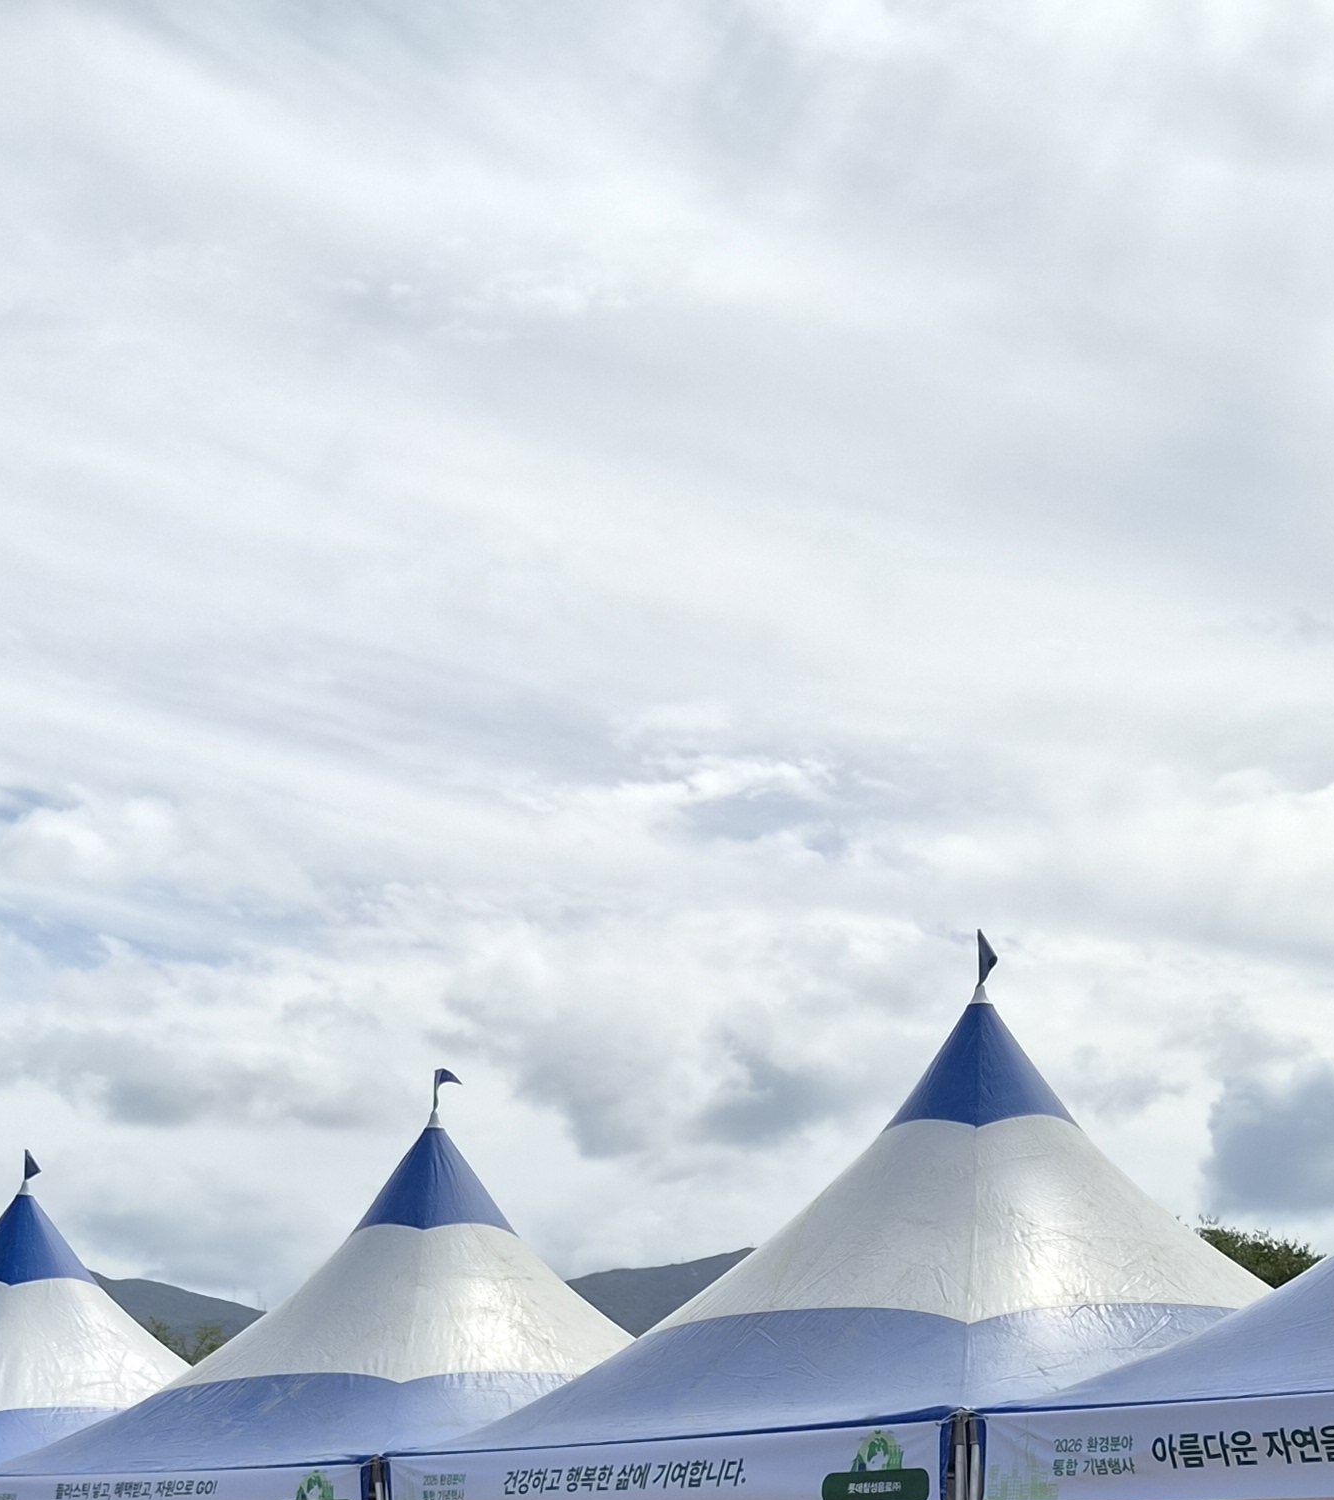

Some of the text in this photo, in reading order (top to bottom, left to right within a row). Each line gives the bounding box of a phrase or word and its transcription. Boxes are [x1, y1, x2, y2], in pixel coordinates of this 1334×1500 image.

[1052, 1434, 1134, 1454] 2026 환경분야
[1150, 1430, 1259, 1471] 아름다운
[502, 1457, 748, 1496] 건강하고 행복한 삶에 기여합니다.
[1052, 1456, 1135, 1477] 통합 기념행사
[55, 1480, 218, 1500] 플라스틱 넣고, 혜택받고, 자원으로 GO!
